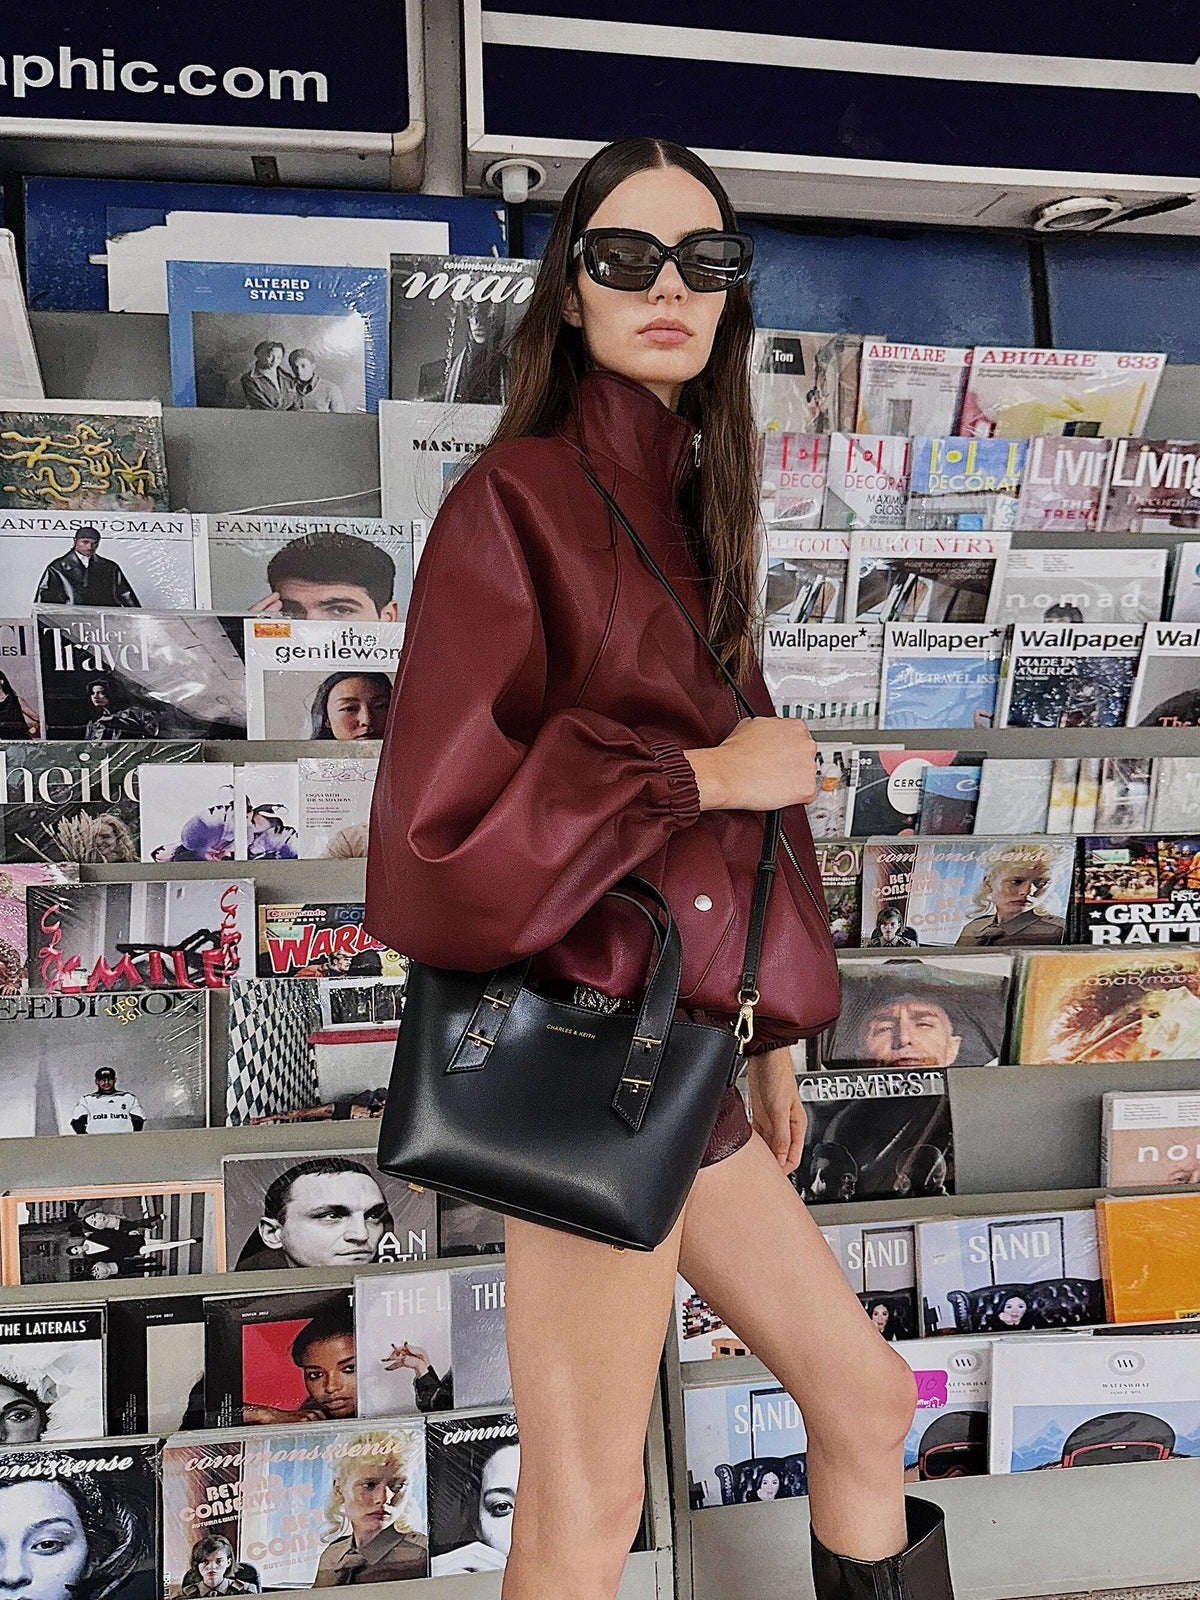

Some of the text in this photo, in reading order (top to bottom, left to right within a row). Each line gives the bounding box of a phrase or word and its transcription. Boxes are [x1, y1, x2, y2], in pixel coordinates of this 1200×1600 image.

[0, 46, 329, 102] phic.com
[244, 277, 310, 291] ALTERED
[250, 290, 305, 302] STATES
[773, 349, 794, 363] Ton
[869, 345, 946, 363] ABITARE
[981, 350, 1159, 370] ABITARE 633
[1006, 581, 1140, 609] nomad
[341, 627, 377, 647] the
[44, 627, 150, 672] Travel
[1018, 657, 1078, 667] MADE IN
[1015, 667, 1079, 676] AMERICA
[104, 996, 139, 1018] UFO
[118, 1008, 143, 1026] 361
[546, 1024, 572, 1034] CHARLES
[578, 1032, 596, 1040] KEITH
[1137, 1144, 1200, 1163] no
[846, 1238, 908, 1270] SAND
[968, 1231, 1051, 1264] SAND
[0, 1320, 87, 1336] THE LATERALS
